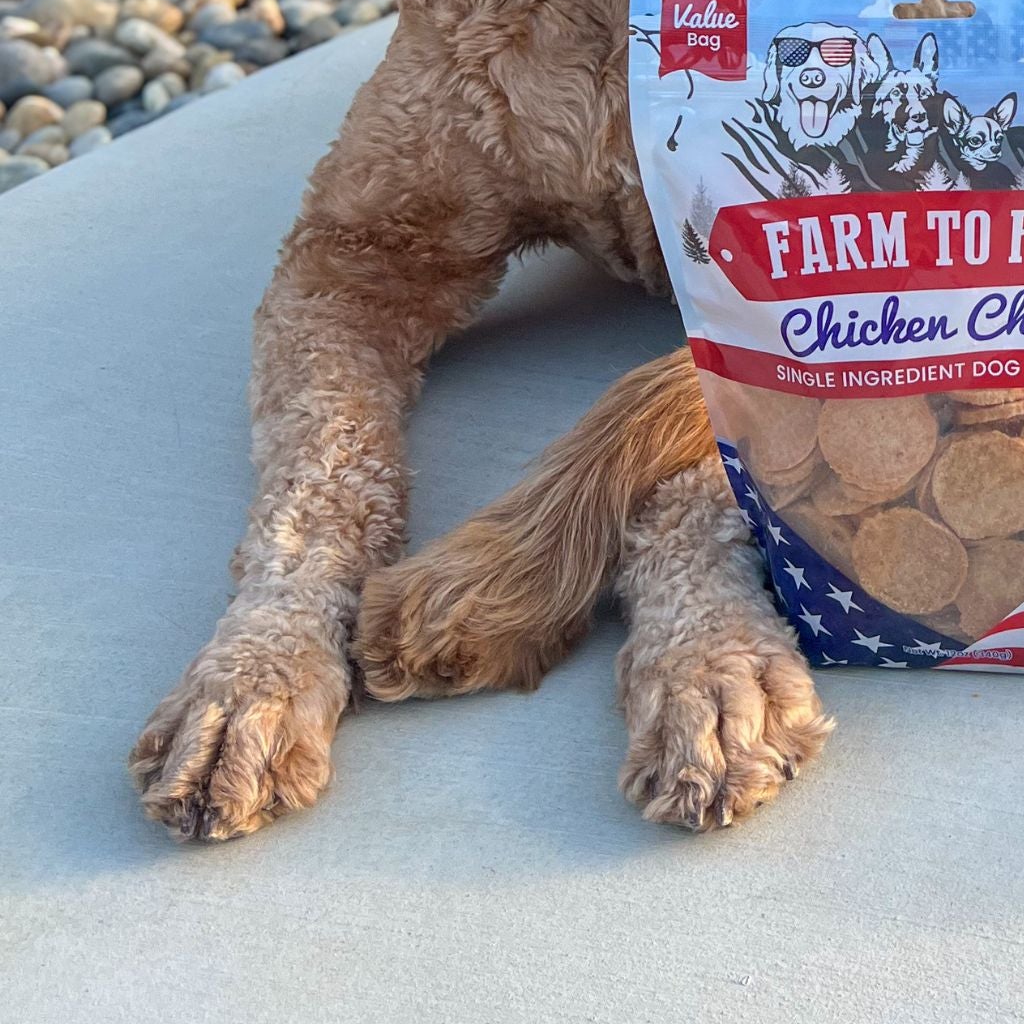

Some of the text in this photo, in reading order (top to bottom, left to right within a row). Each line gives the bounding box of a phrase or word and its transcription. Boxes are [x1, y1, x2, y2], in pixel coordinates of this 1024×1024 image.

[673, 0, 740, 30] Value
[686, 31, 721, 52] Bag
[762, 210, 909, 281] FARM
[926, 209, 992, 267] TO
[779, 295, 958, 359] Chicken
[776, 364, 836, 388] SINGLE
[843, 362, 966, 388] INGREDIENT
[972, 359, 1021, 378] DOG
